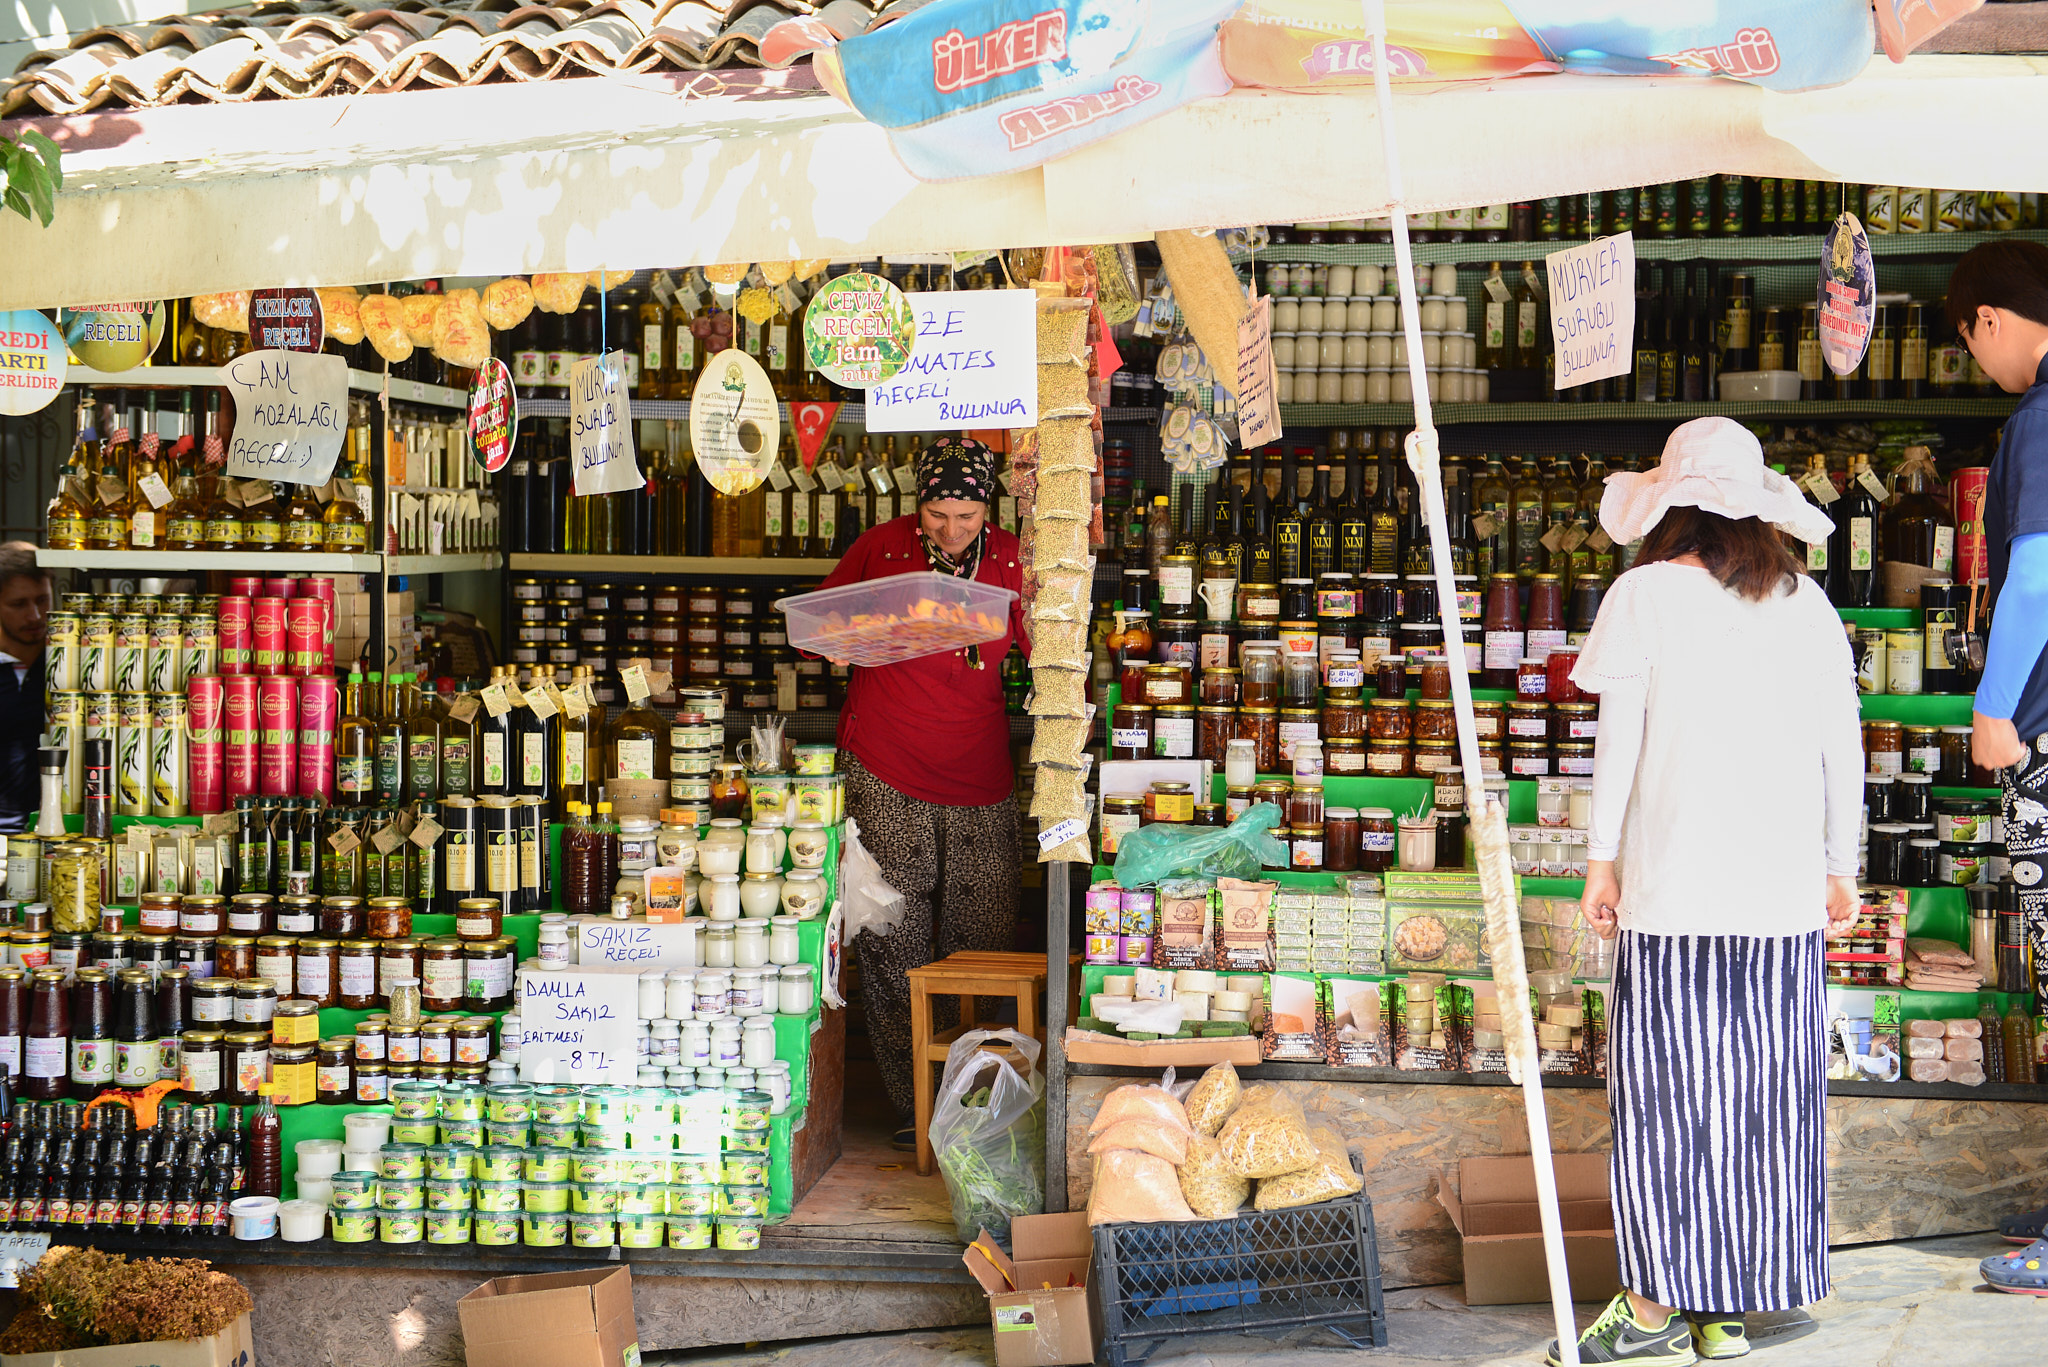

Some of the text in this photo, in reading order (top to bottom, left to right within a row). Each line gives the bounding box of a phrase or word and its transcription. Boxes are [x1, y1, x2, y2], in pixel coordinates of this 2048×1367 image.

[933, 11, 1067, 93] ÜLKER
[1552, 242, 1622, 305] MÜRVER
[256, 298, 313, 317] KIZILCIK
[828, 288, 884, 311] CEVİZ
[84, 321, 142, 347] REÇELİ
[917, 310, 966, 337] ZE
[1558, 301, 1615, 347] ŞURUBU
[0, 329, 49, 351] REDİ
[0, 354, 45, 371] ARTI
[836, 341, 882, 367] jam
[1563, 332, 1617, 378] BULUNUR
[0, 373, 59, 390] ERLİDİR
[231, 361, 298, 394] ÇAM
[575, 360, 621, 405] MÜRVE
[841, 366, 880, 382] nut
[469, 378, 508, 411] DOMATES
[872, 379, 949, 406] REÇELİ
[254, 401, 339, 431] KOZALAĞI
[939, 398, 1026, 422] BULUNUR
[475, 426, 507, 450] tomato
[486, 443, 505, 464] jam
[1279, 533, 1298, 544] XLXI
[1313, 537, 1332, 548] XLXI
[1344, 537, 1363, 548] XLXI
[1254, 551, 1270, 559] XLXI
[489, 849, 504, 857] 10.10
[584, 927, 652, 949] SAKIZ
[605, 945, 662, 961] REÇELİ
[525, 979, 586, 998] DAMLA
[555, 1003, 616, 1022] SAKIZ
[520, 1028, 585, 1045] ERİTMESİ
[9, 1237, 42, 1248] APFEL
